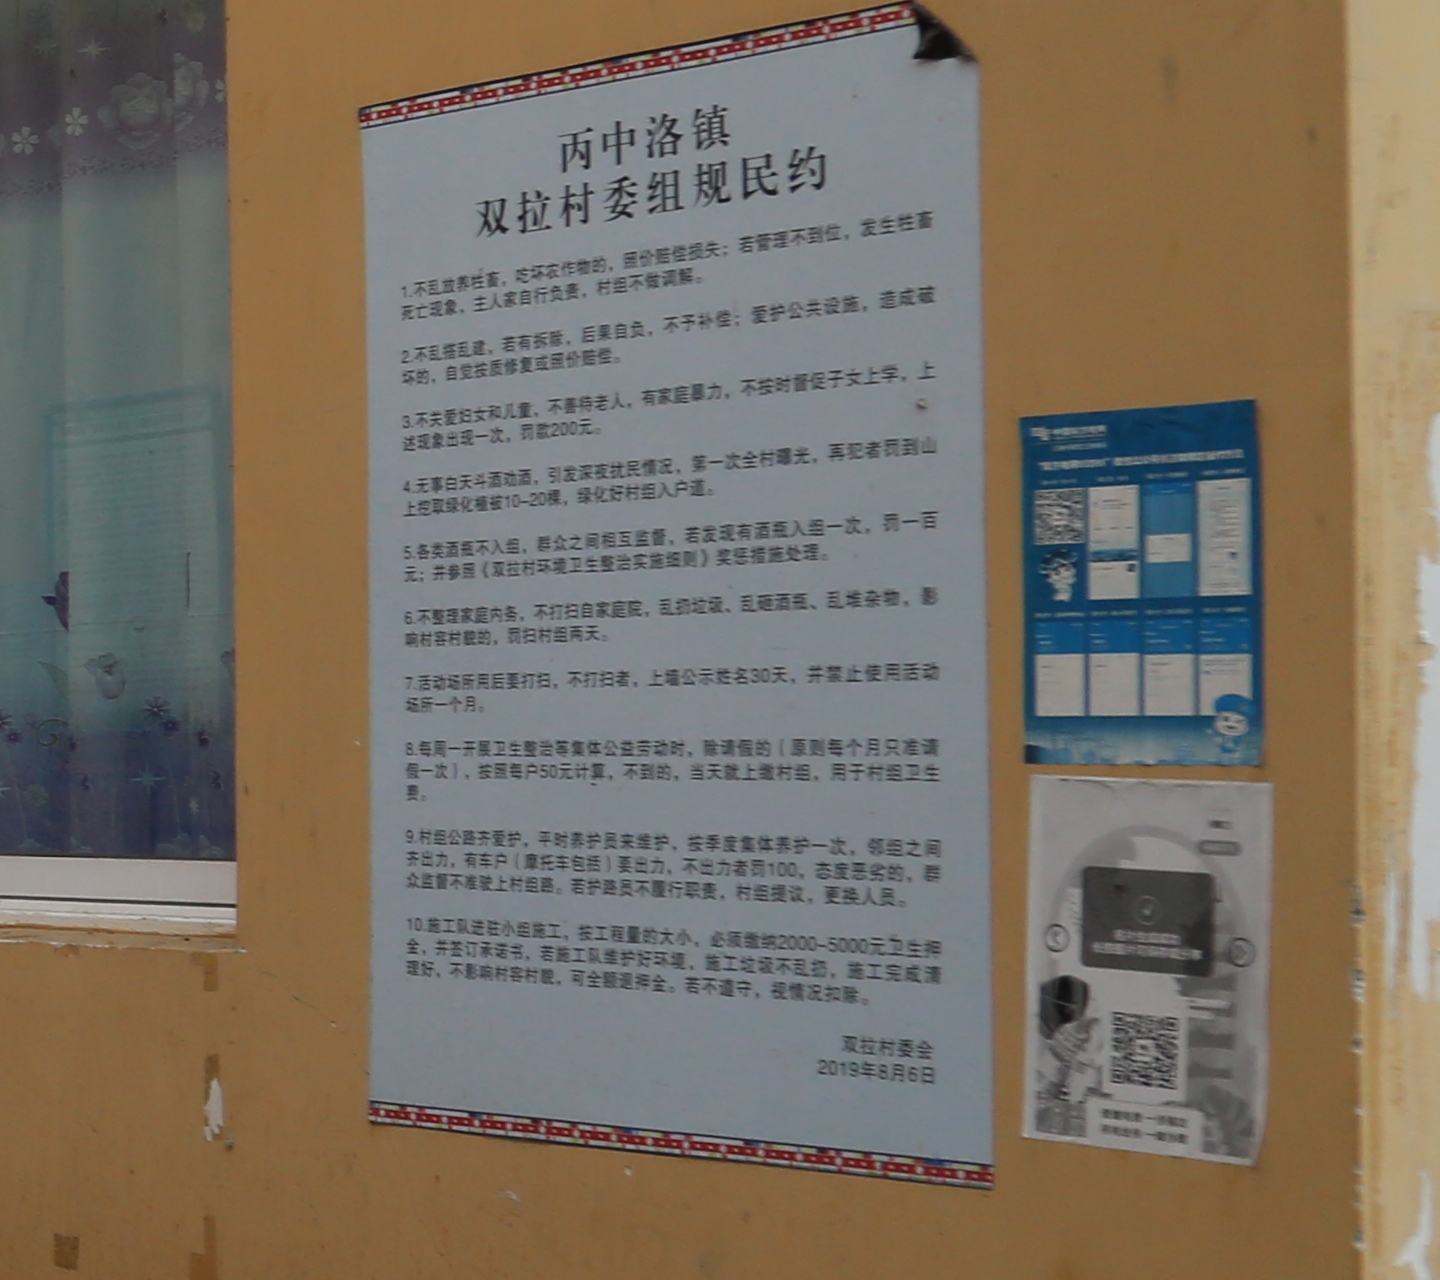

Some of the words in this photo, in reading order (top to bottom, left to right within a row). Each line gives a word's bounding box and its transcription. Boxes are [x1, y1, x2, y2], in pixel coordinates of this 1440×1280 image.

[558, 105, 731, 173] 丙中洛镇
[474, 145, 828, 239] 双拉村委组规民约
[841, 1035, 933, 1060] 双拉村委会
[817, 1059, 936, 1085] 2019年8月6日
